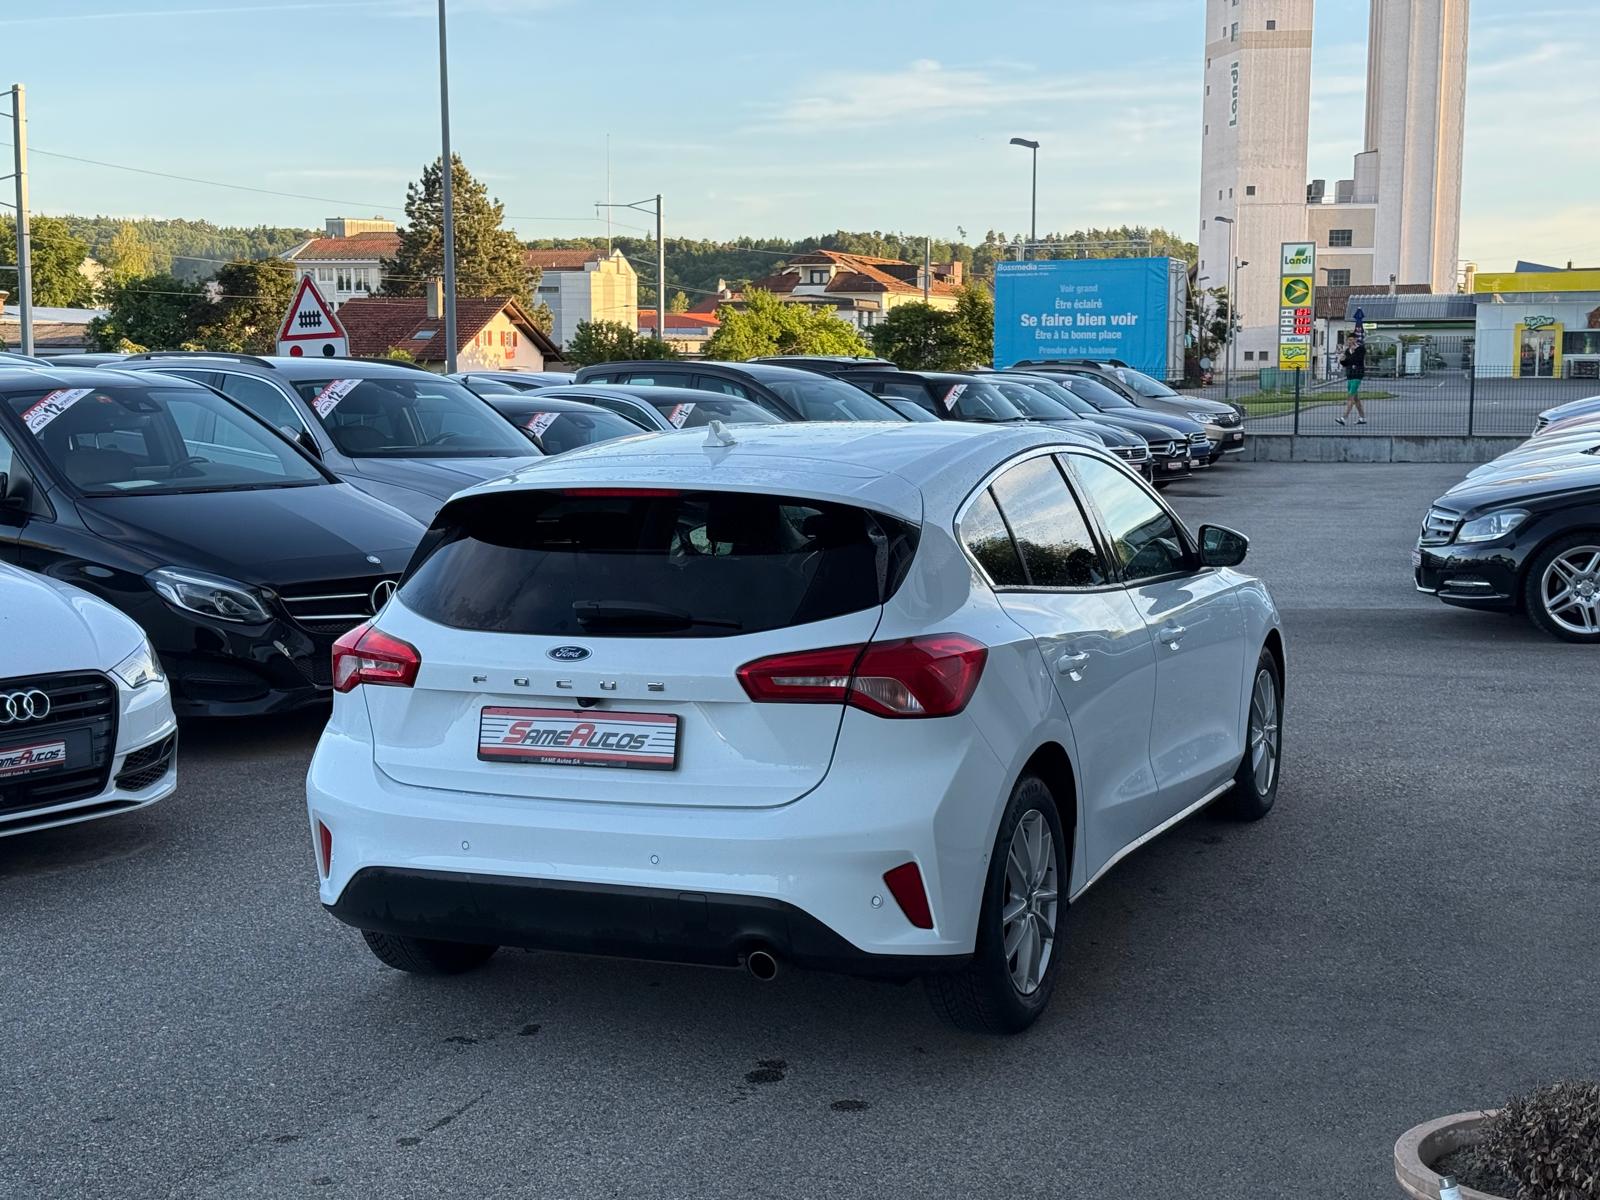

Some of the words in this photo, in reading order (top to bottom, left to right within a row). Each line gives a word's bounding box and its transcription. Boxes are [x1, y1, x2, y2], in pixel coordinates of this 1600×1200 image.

[1229, 61, 1239, 127] Landi
[1284, 256, 1312, 265] Landi
[1060, 284, 1075, 293] Voir
[1076, 284, 1098, 294] grand
[1055, 298, 1072, 309] Être
[1074, 298, 1103, 309] éclairé
[1020, 313, 1038, 327] Se
[1041, 313, 1073, 326] faire
[1076, 312, 1107, 326] bien
[1110, 312, 1139, 326] voir
[1035, 329, 1052, 340] Être
[1053, 330, 1059, 340] à
[1061, 330, 1069, 340] la
[1071, 330, 1097, 340] bonne
[1099, 330, 1122, 341] place
[1068, 346, 1077, 354] de
[1080, 346, 1087, 354] la
[328, 391, 343, 402] 12
[44, 403, 65, 415] 12
[473, 675, 665, 692] FOCUS
